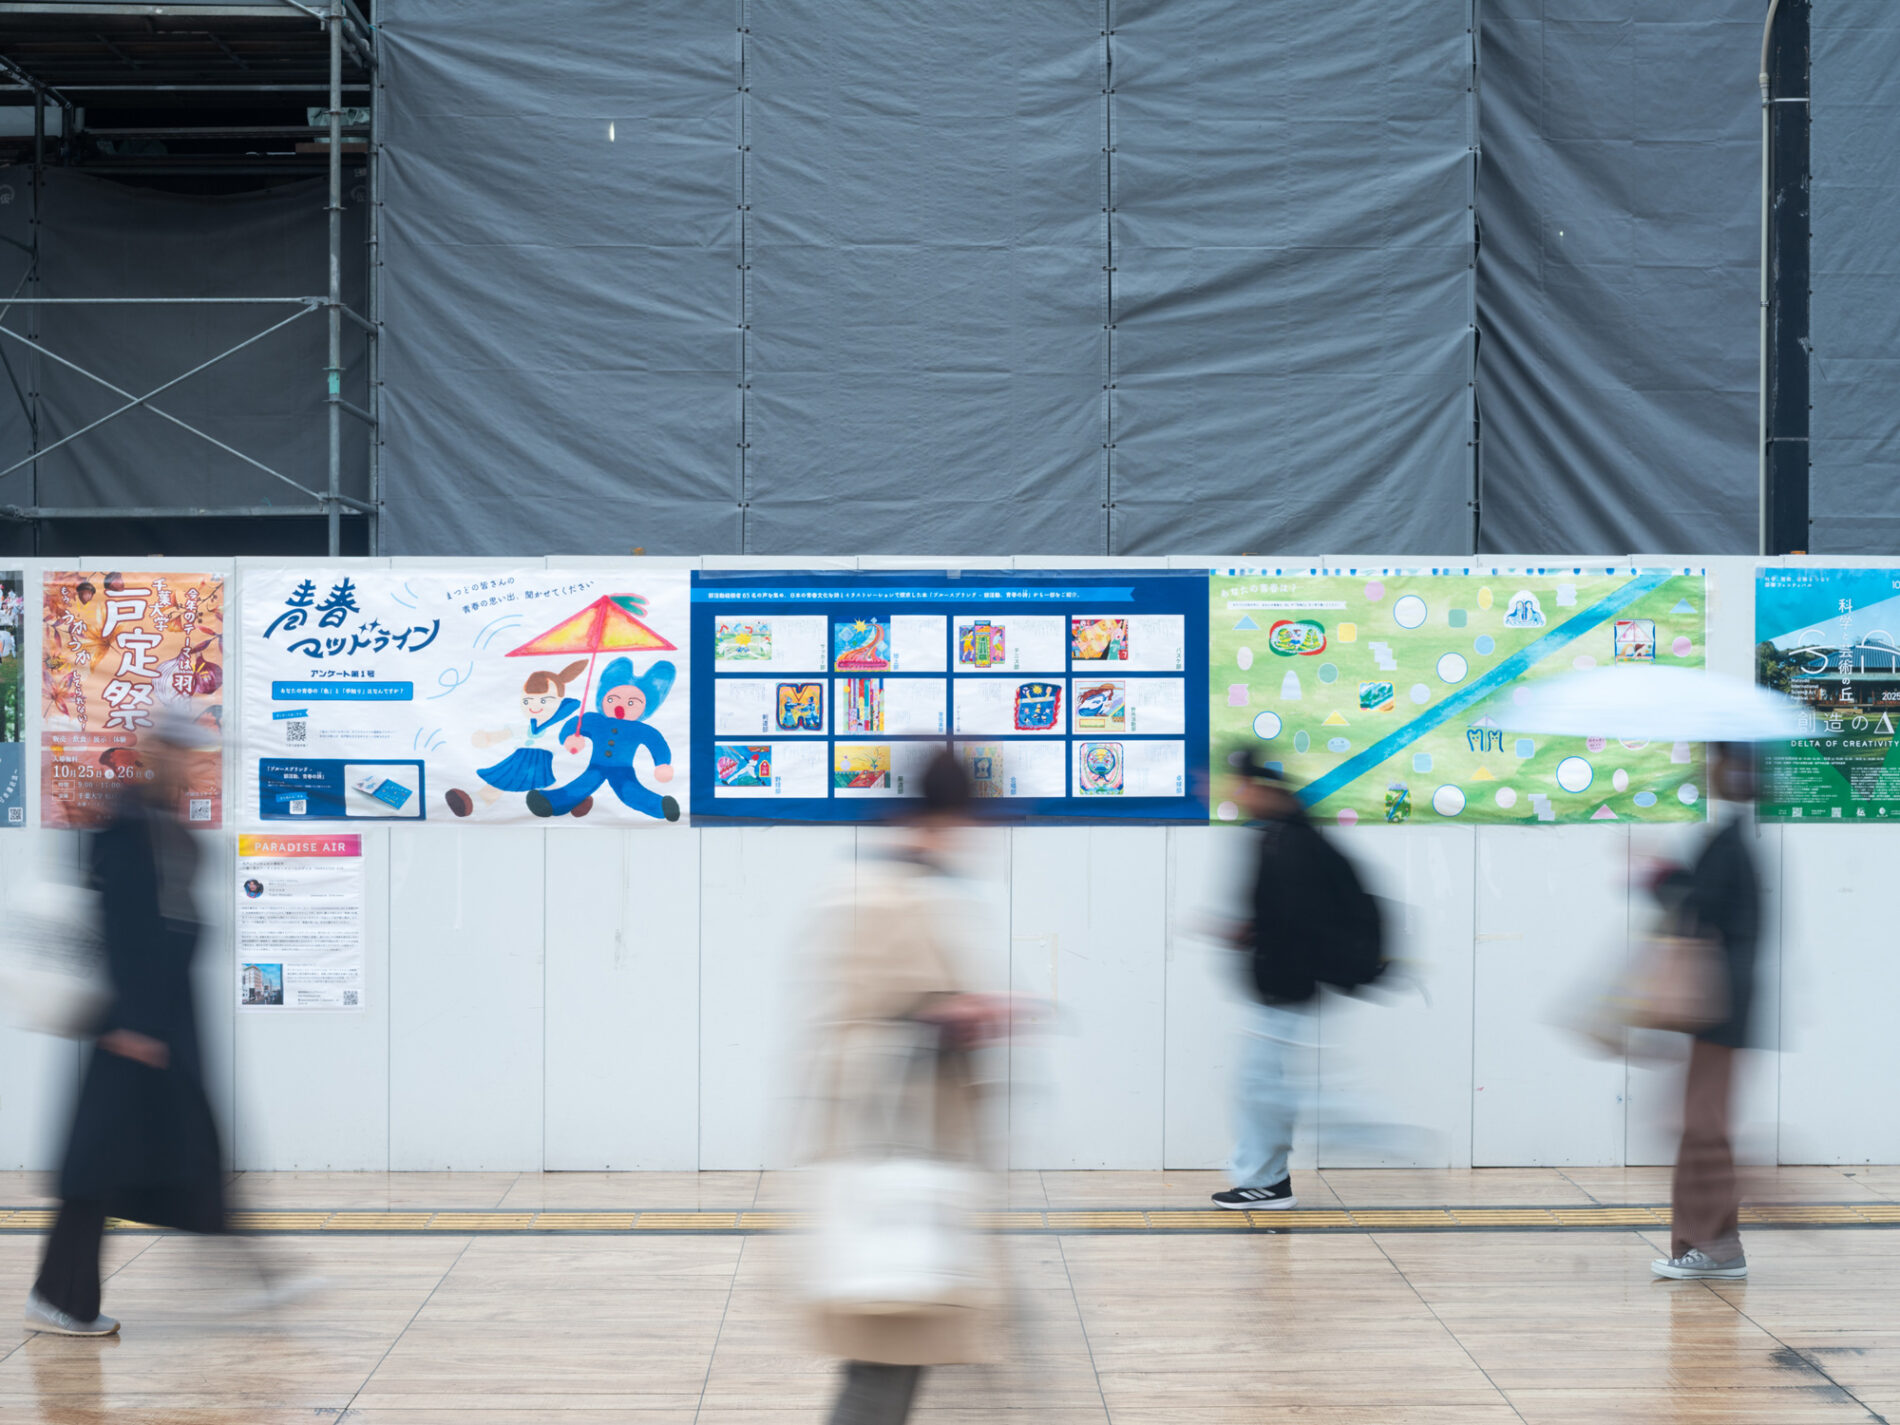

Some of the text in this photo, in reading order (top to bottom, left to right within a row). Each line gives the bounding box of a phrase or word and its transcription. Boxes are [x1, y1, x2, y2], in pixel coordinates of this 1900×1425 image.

[149, 578, 171, 631] 千葉大学
[102, 588, 163, 731] 戸定祭
[254, 842, 346, 851] PARADISE AIR
